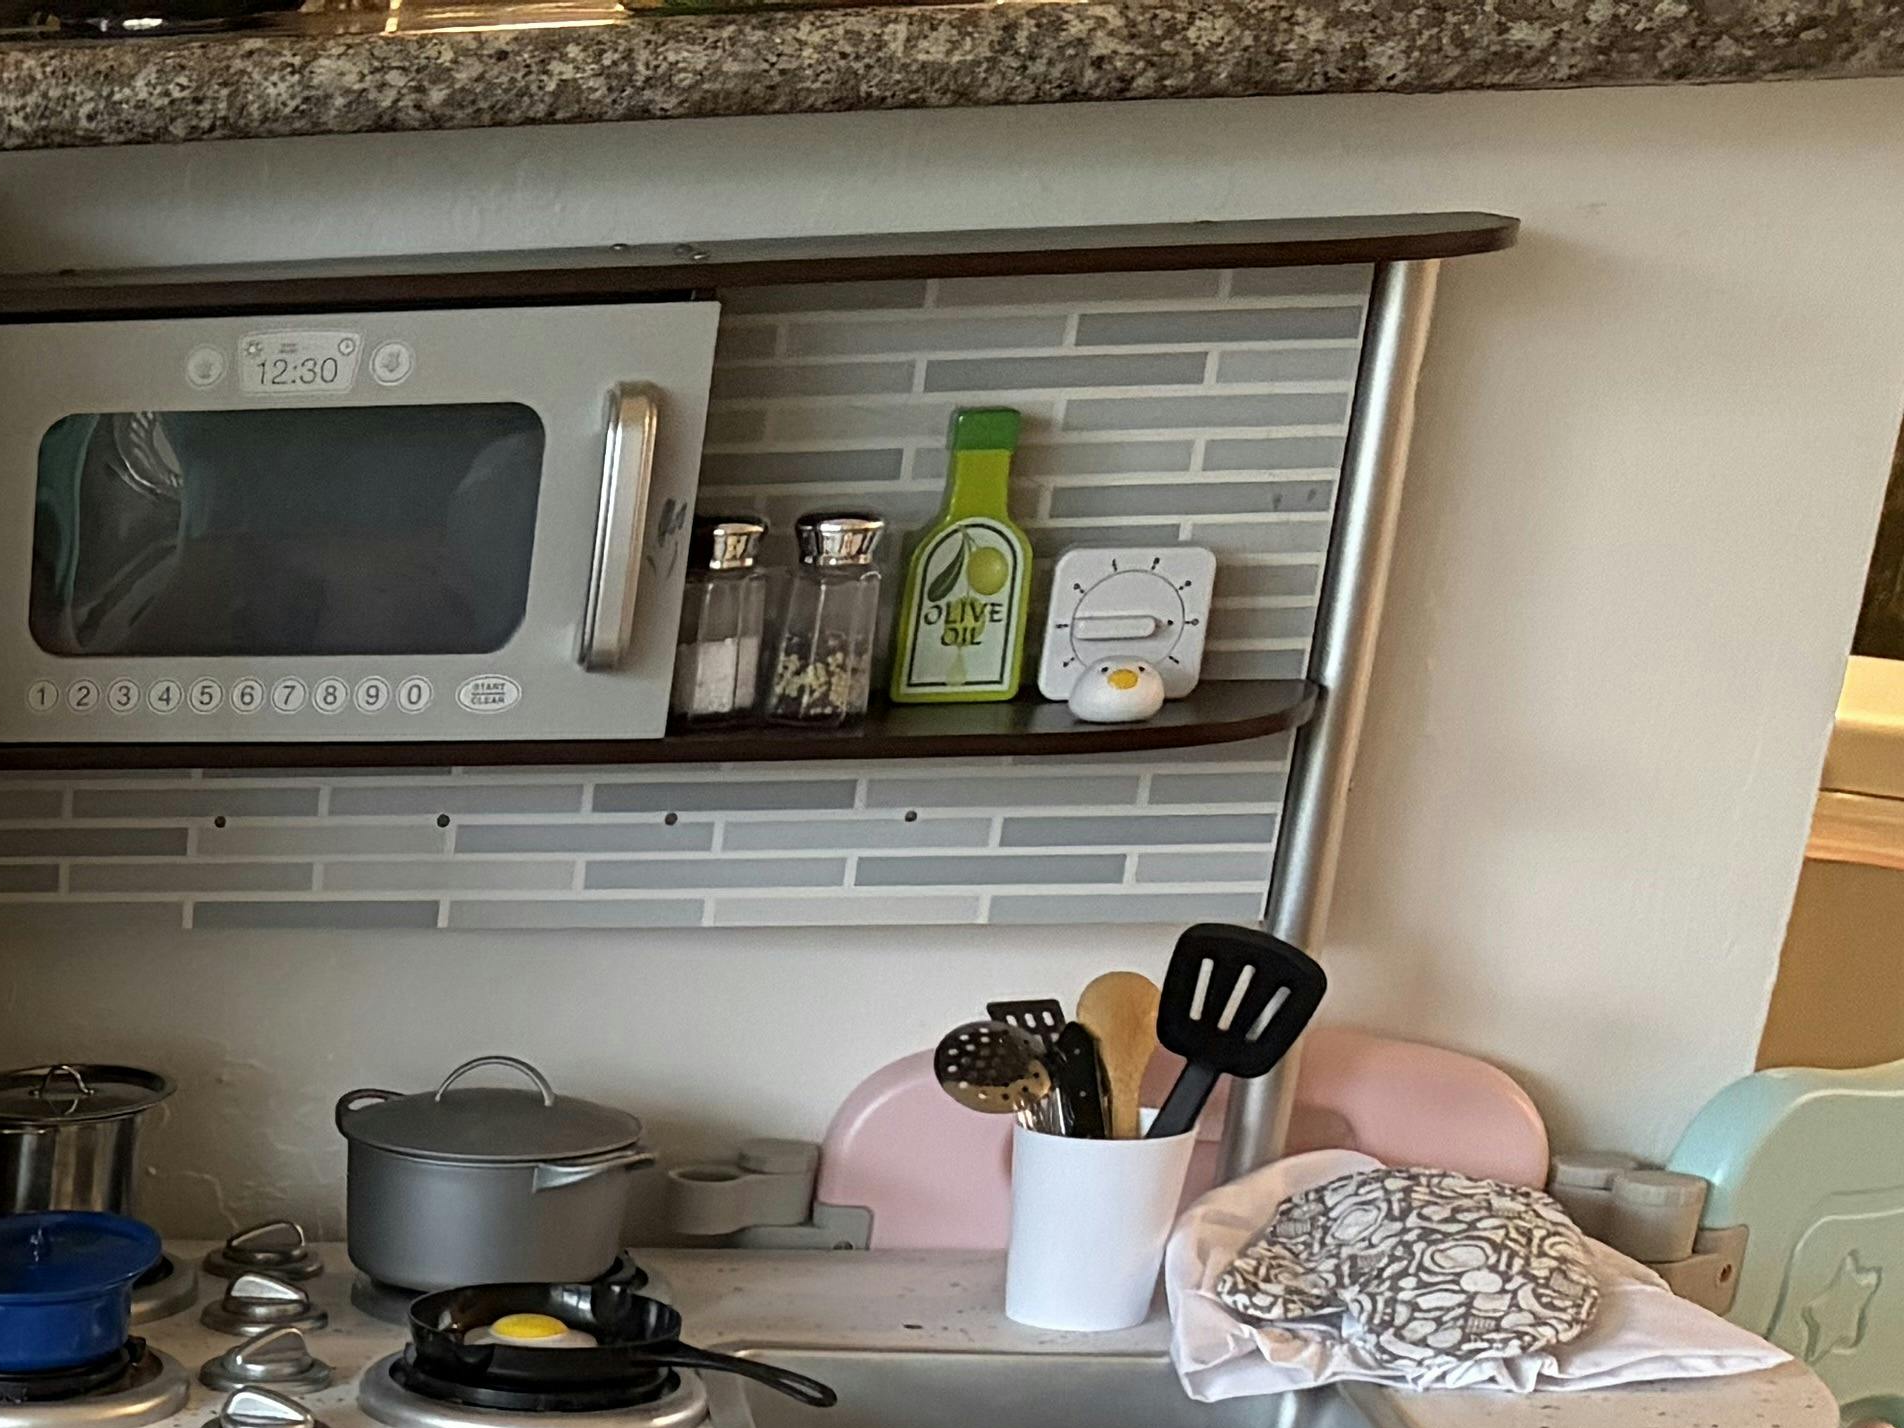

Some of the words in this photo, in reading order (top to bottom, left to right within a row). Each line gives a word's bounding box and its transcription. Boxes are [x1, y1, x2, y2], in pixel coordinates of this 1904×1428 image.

[257, 357, 338, 385] 12:30
[924, 601, 1003, 625] OLIVE
[941, 627, 982, 646] OIL
[37, 687, 45, 706] 1
[76, 686, 90, 707] 2
[117, 685, 130, 706] 3
[158, 686, 170, 706] 4
[199, 685, 213, 706] 5
[240, 685, 255, 706] 6
[282, 685, 296, 705] 7
[323, 685, 337, 705] 8
[366, 685, 379, 705] 9
[407, 684, 421, 705] 0
